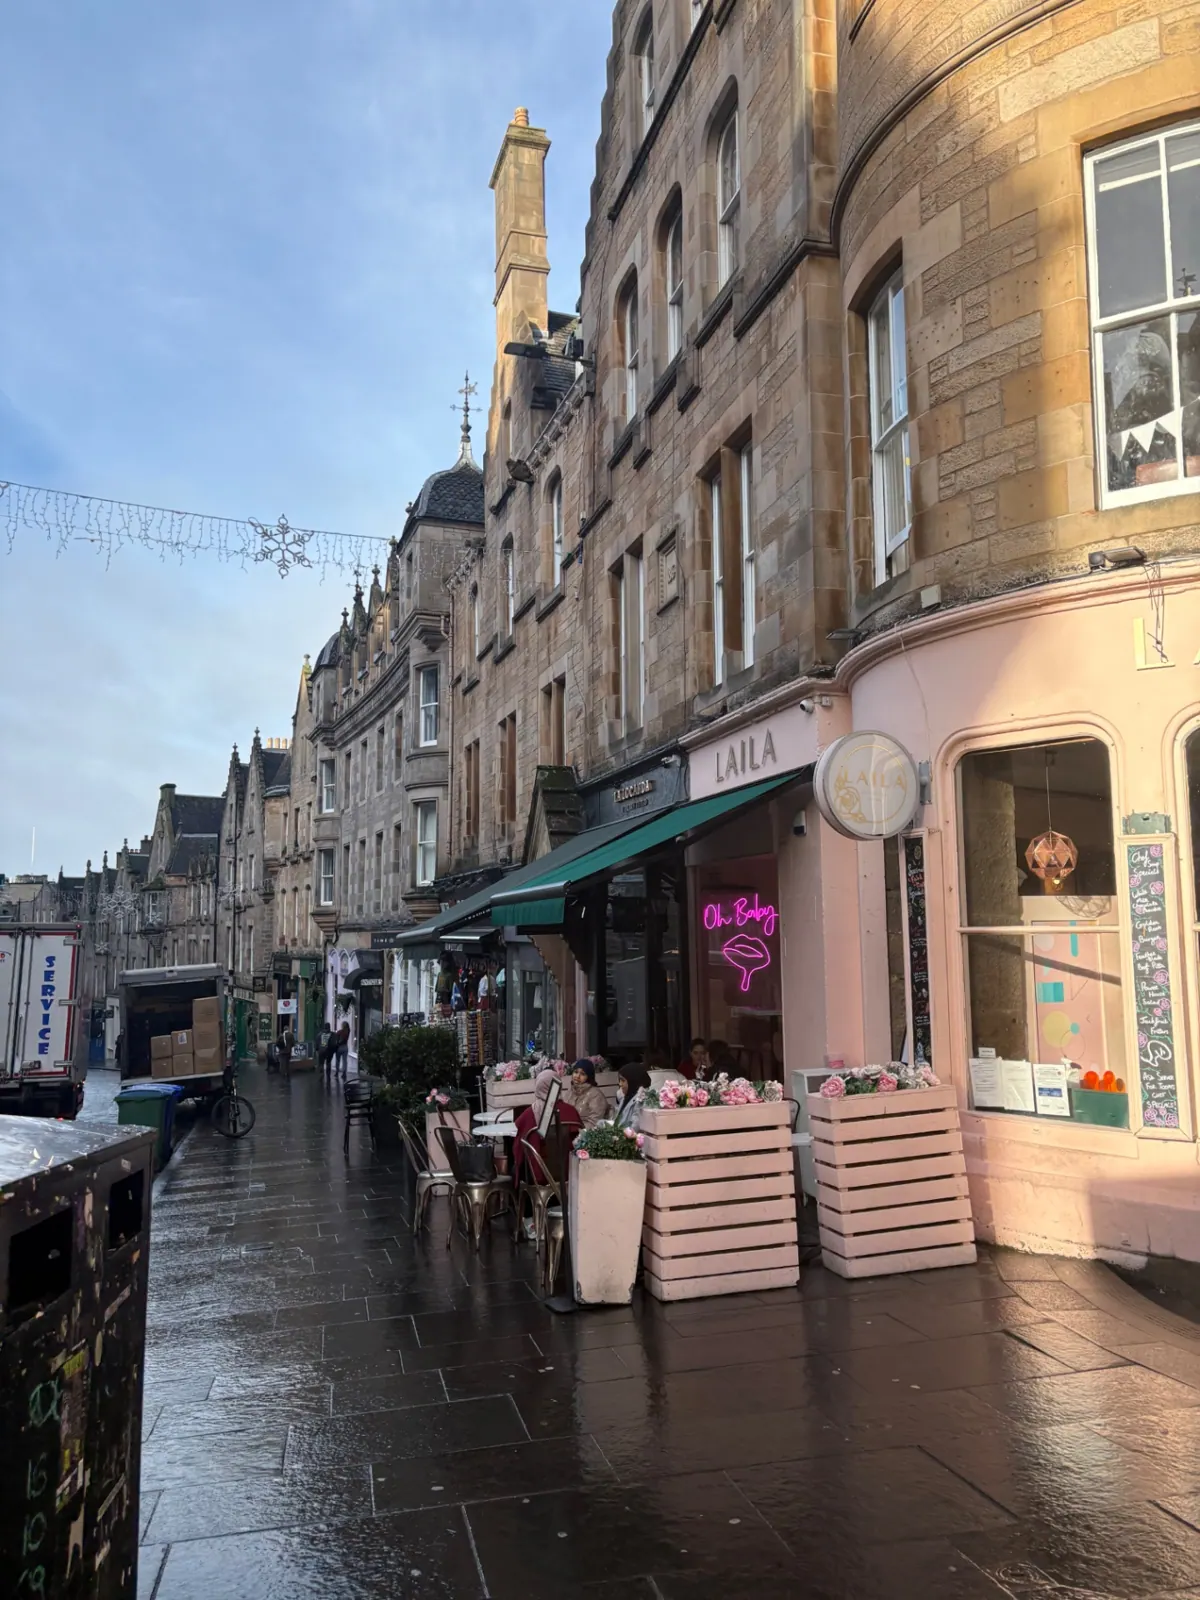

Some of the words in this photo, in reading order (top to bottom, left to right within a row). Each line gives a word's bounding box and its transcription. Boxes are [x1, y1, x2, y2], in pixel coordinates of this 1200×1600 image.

[716, 727, 777, 783] LAILA
[843, 768, 906, 792] LAILA
[704, 903, 732, 930] Oh
[733, 893, 779, 936] Baby
[37, 955, 56, 1055] SERVICE
